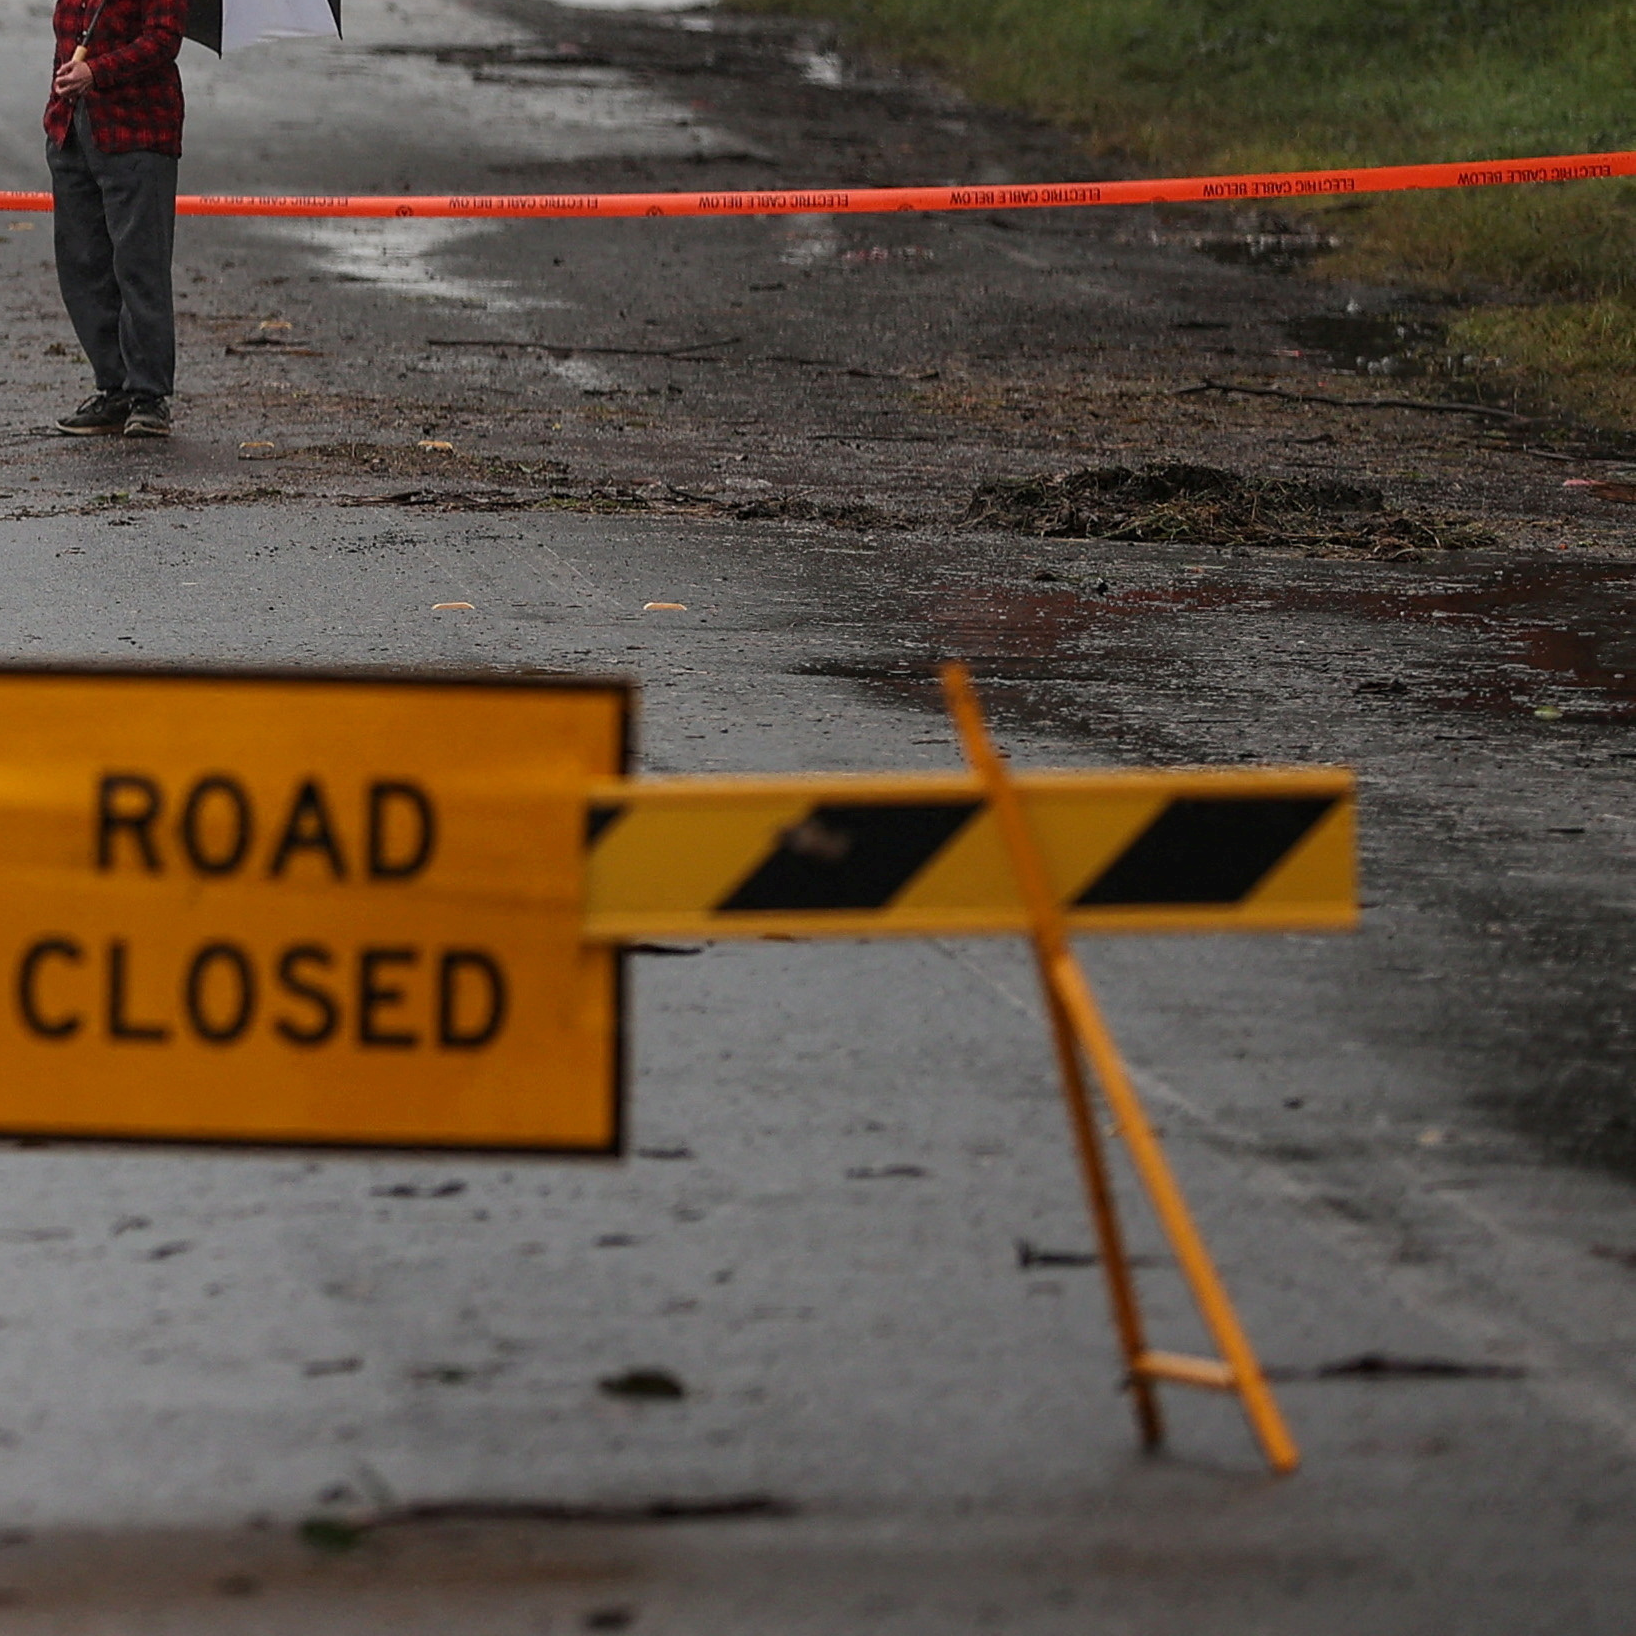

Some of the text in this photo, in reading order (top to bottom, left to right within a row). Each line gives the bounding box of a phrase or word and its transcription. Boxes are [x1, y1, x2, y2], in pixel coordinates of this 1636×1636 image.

[1457, 165, 1611, 185] ELECTRIC CABLE BELOW
[950, 187, 1101, 206] ELECTRIC CABLE BELOW
[1203, 178, 1355, 197] ELECTRIC CABLE BELOW
[449, 197, 598, 210] ELECTRIC CABLE BELOW
[699, 193, 849, 209] ELECTRIC CABLE BELOW
[91, 772, 437, 881] ROAD
[15, 936, 509, 1049] CLOSED
